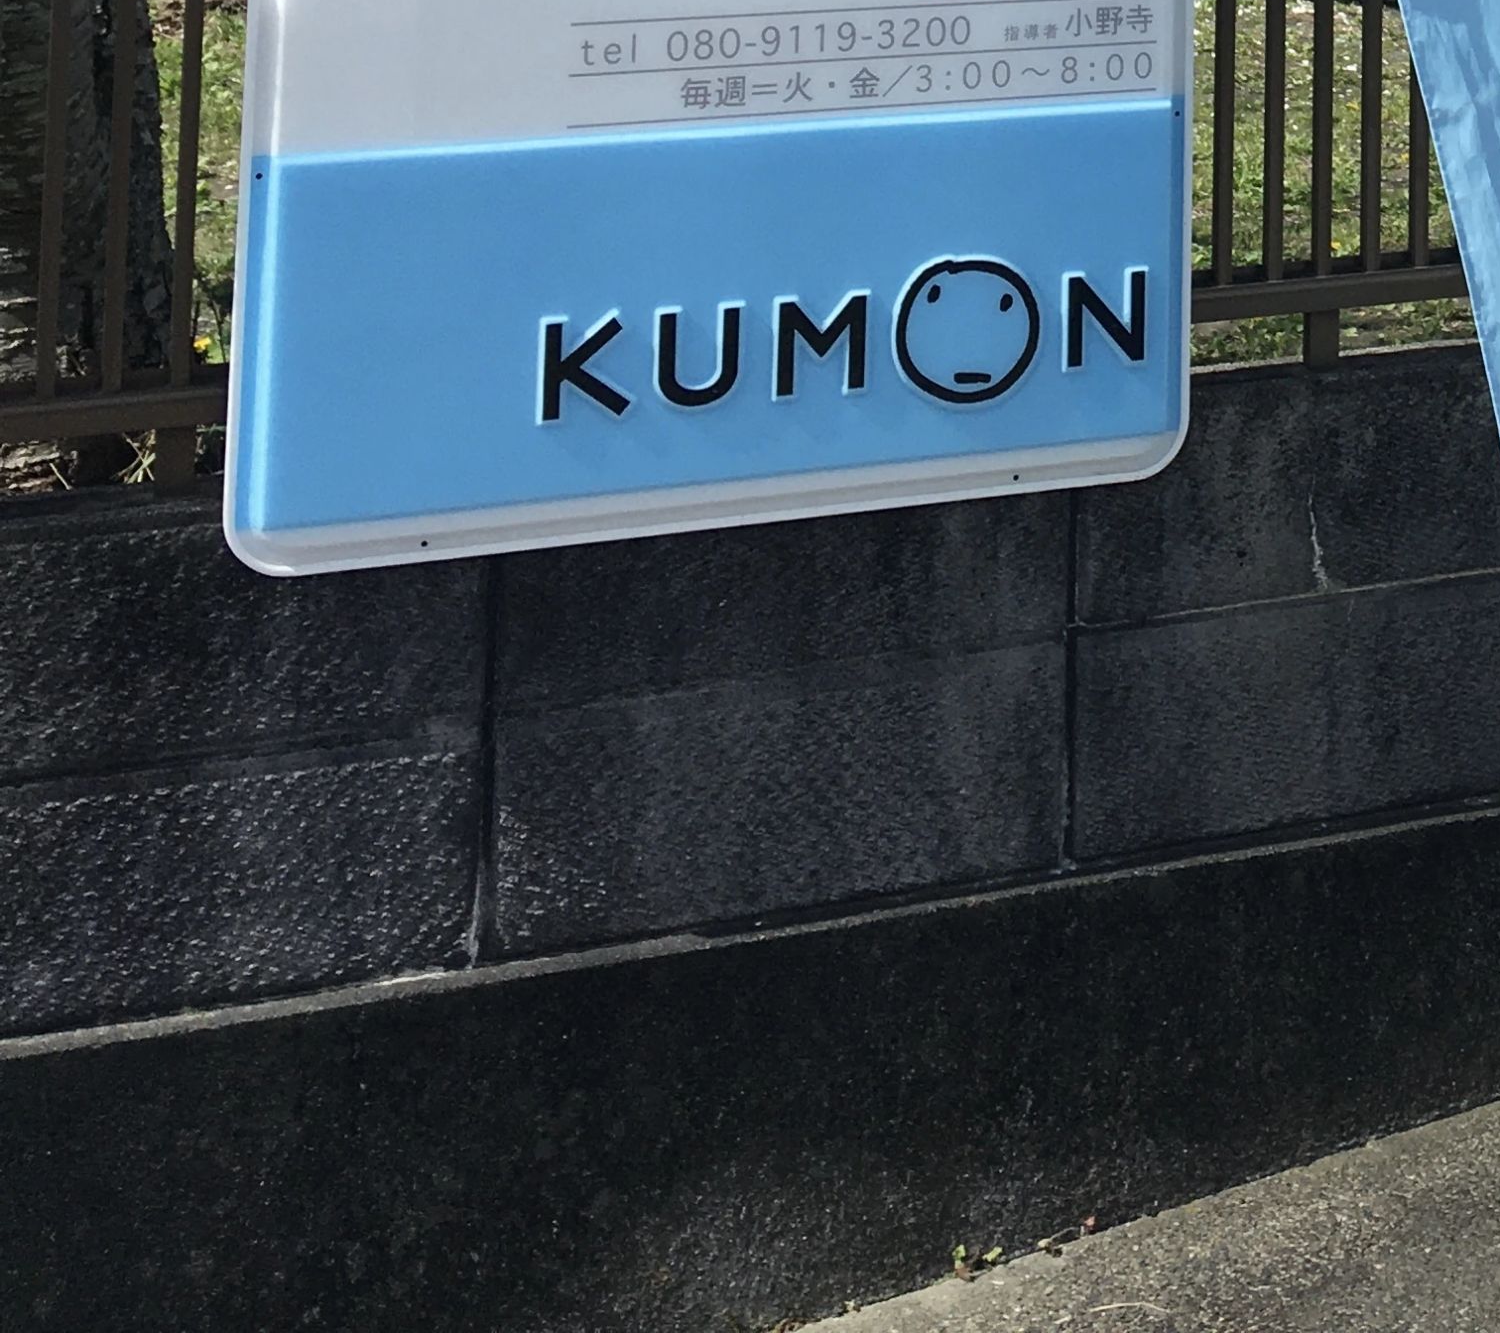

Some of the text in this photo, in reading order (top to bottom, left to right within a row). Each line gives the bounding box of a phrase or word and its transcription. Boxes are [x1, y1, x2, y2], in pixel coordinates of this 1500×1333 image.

[580, 32, 637, 67] tel
[666, 15, 971, 63] 080-9119-3200
[1064, 4, 1154, 38] 小野寺
[540, 255, 1148, 423] KUMON
